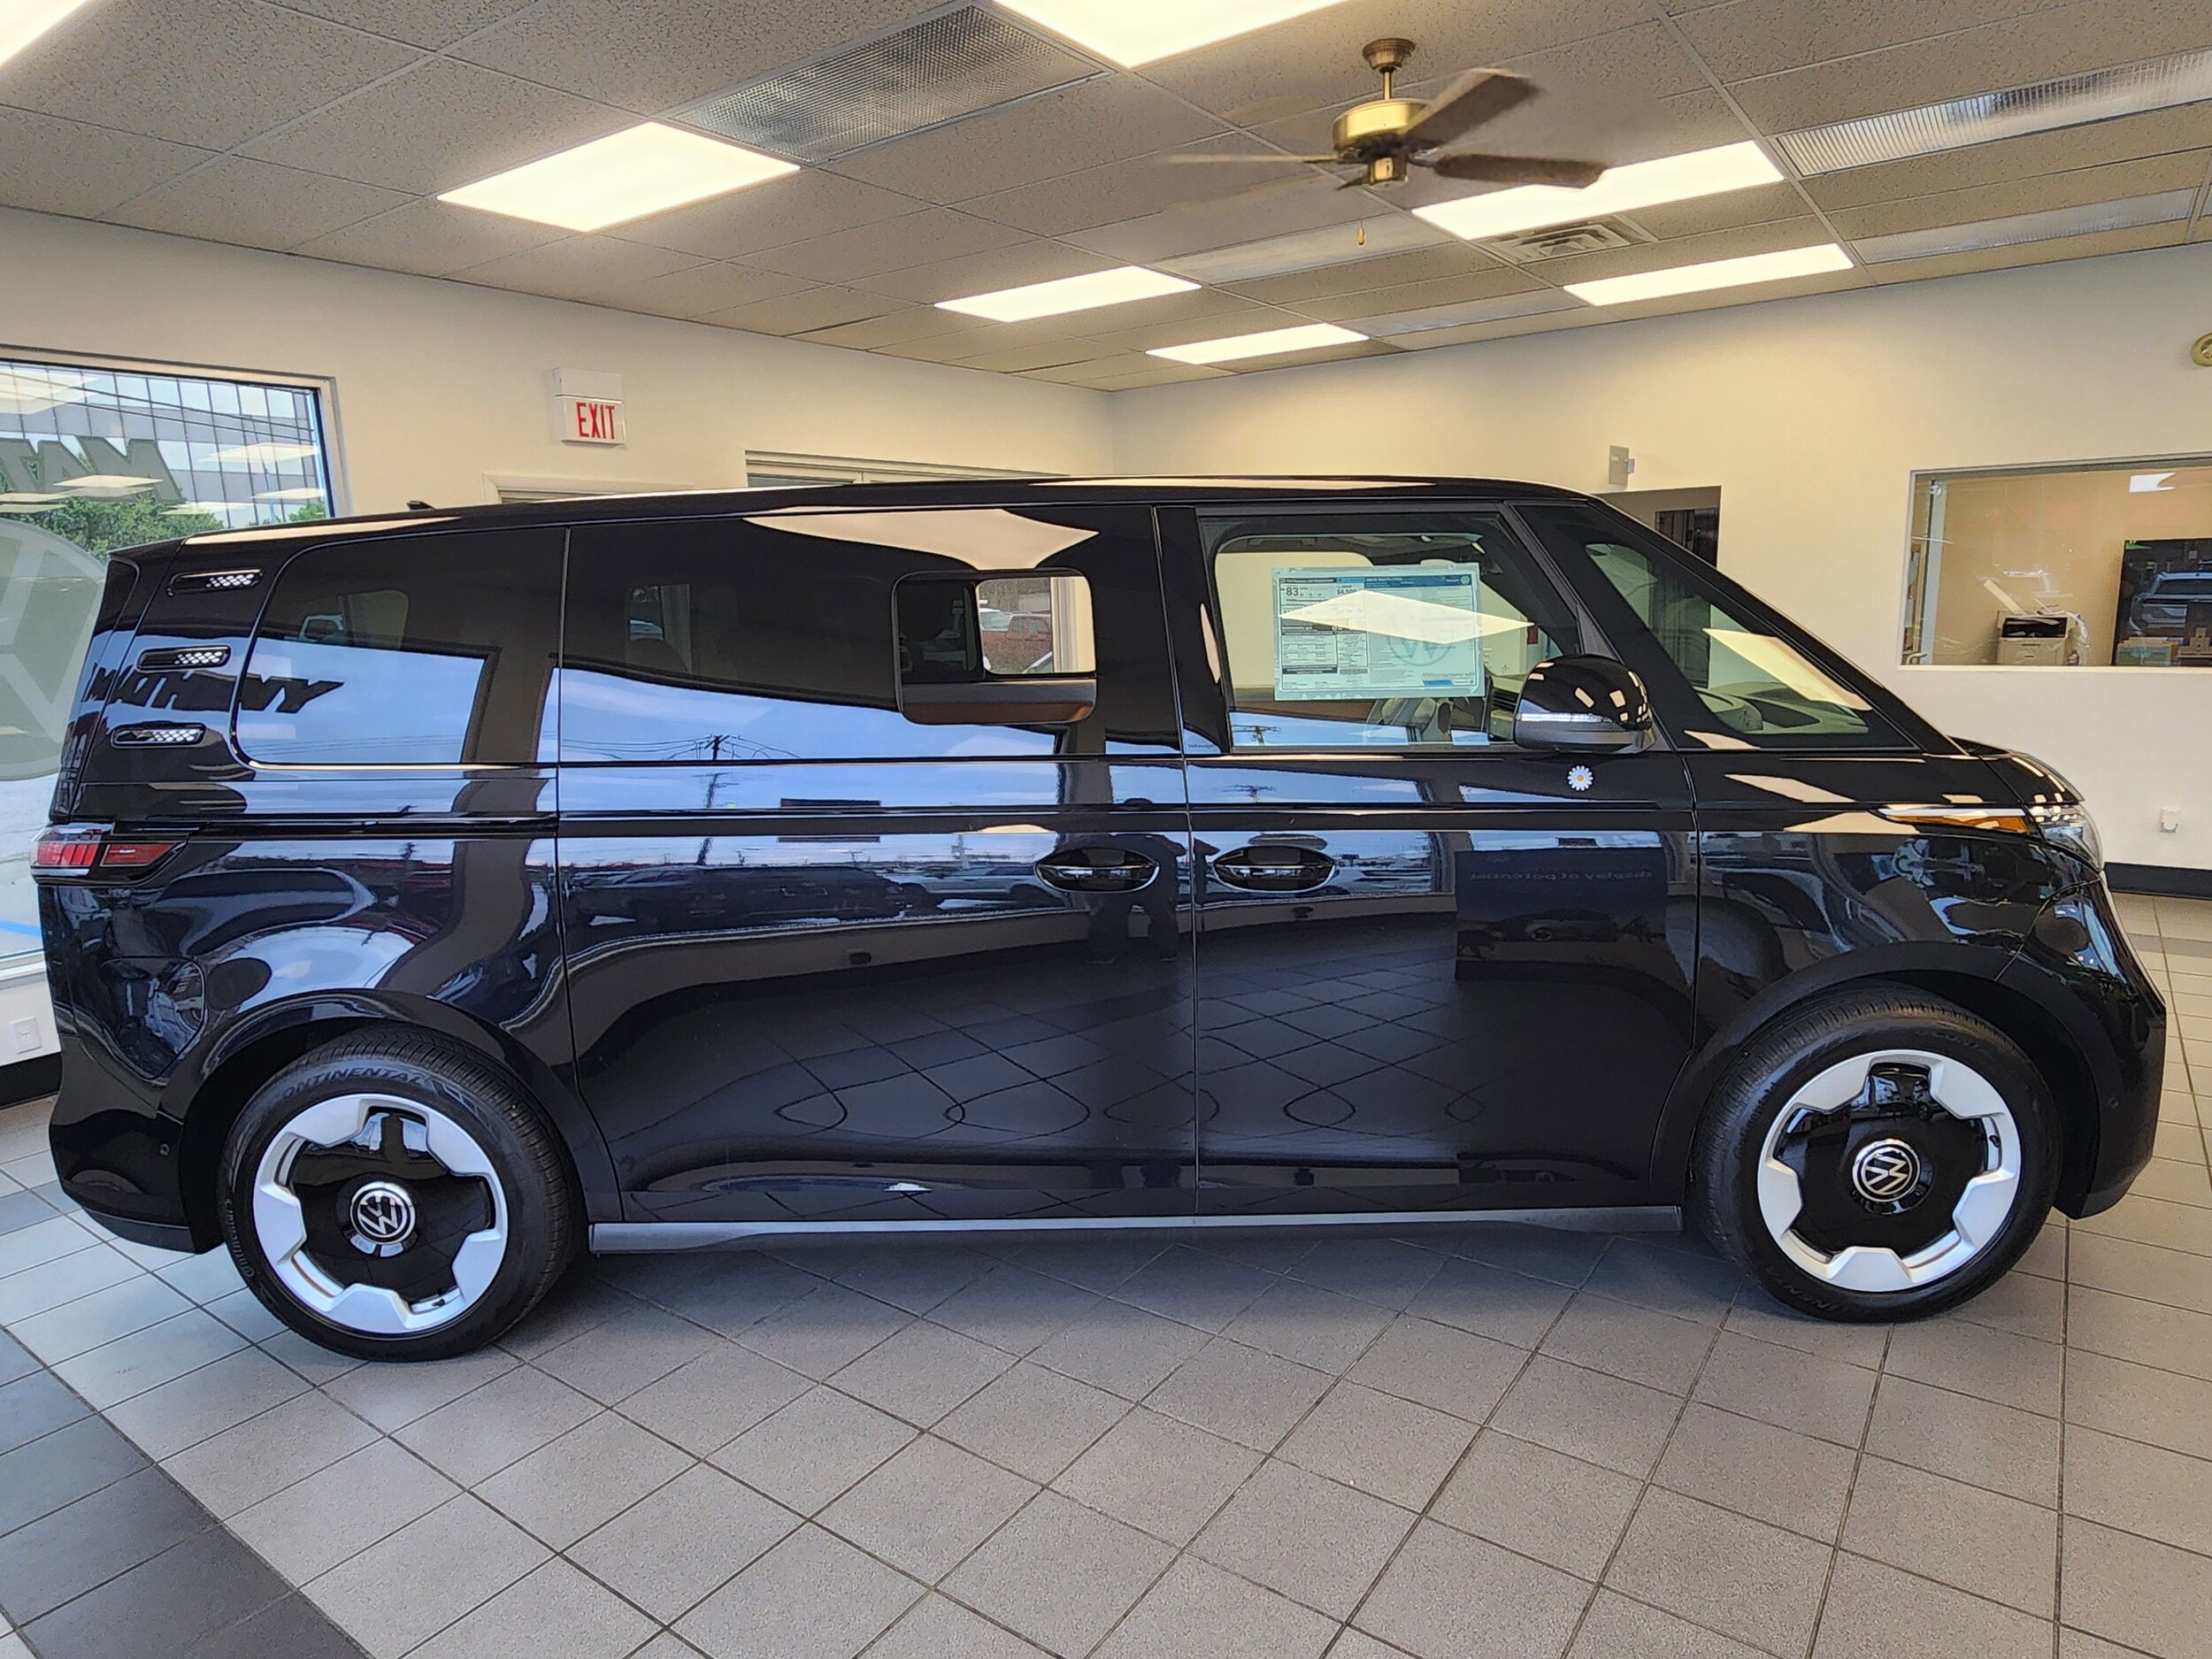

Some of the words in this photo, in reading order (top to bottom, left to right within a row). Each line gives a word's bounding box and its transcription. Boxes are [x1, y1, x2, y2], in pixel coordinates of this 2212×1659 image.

[575, 401, 616, 441] EXIT
[1286, 587, 1299, 596] 83
[281, 1067, 423, 1099] ONTINENTAL
